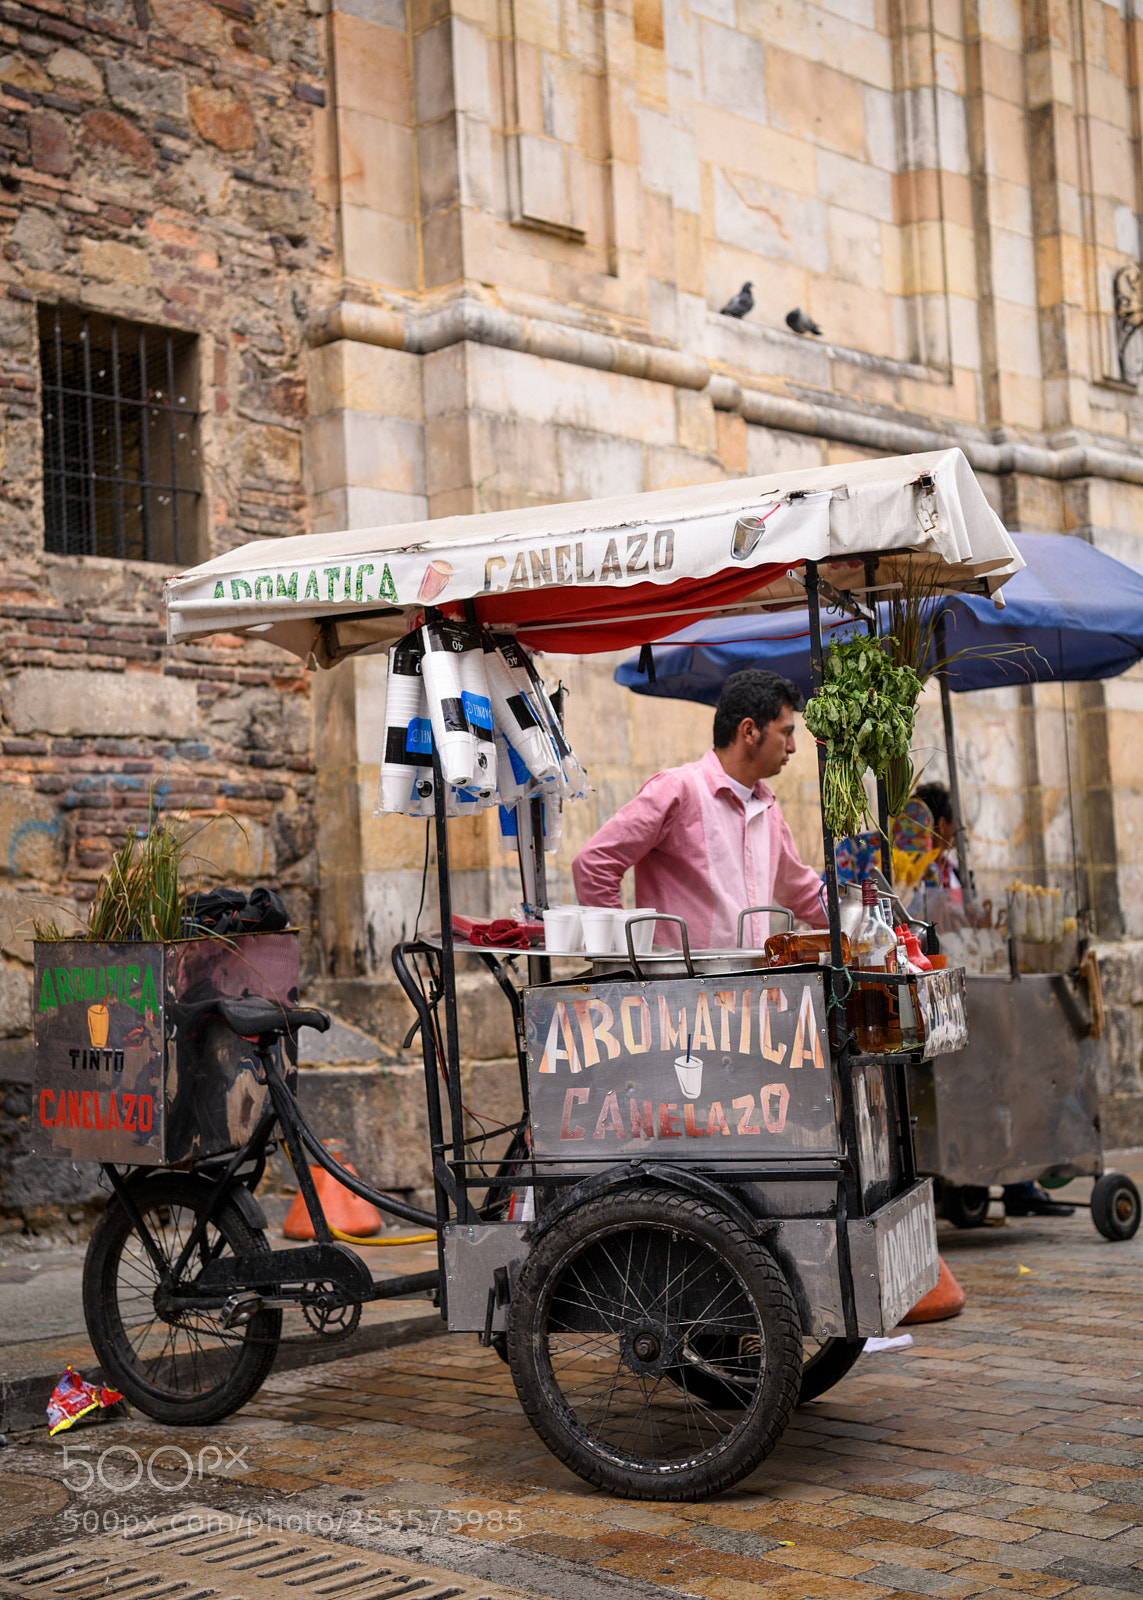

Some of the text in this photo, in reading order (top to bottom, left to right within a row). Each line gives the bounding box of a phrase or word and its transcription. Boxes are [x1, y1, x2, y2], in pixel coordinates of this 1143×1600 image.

[484, 528, 675, 592] CANELAZO
[452, 640, 464, 652] 40
[39, 964, 159, 1014] AROMATICA
[538, 985, 825, 1074] AROMATICA
[69, 1048, 124, 1073] TINTO
[39, 1089, 153, 1132] CANELAZO
[560, 1083, 790, 1141] CANELAZO
